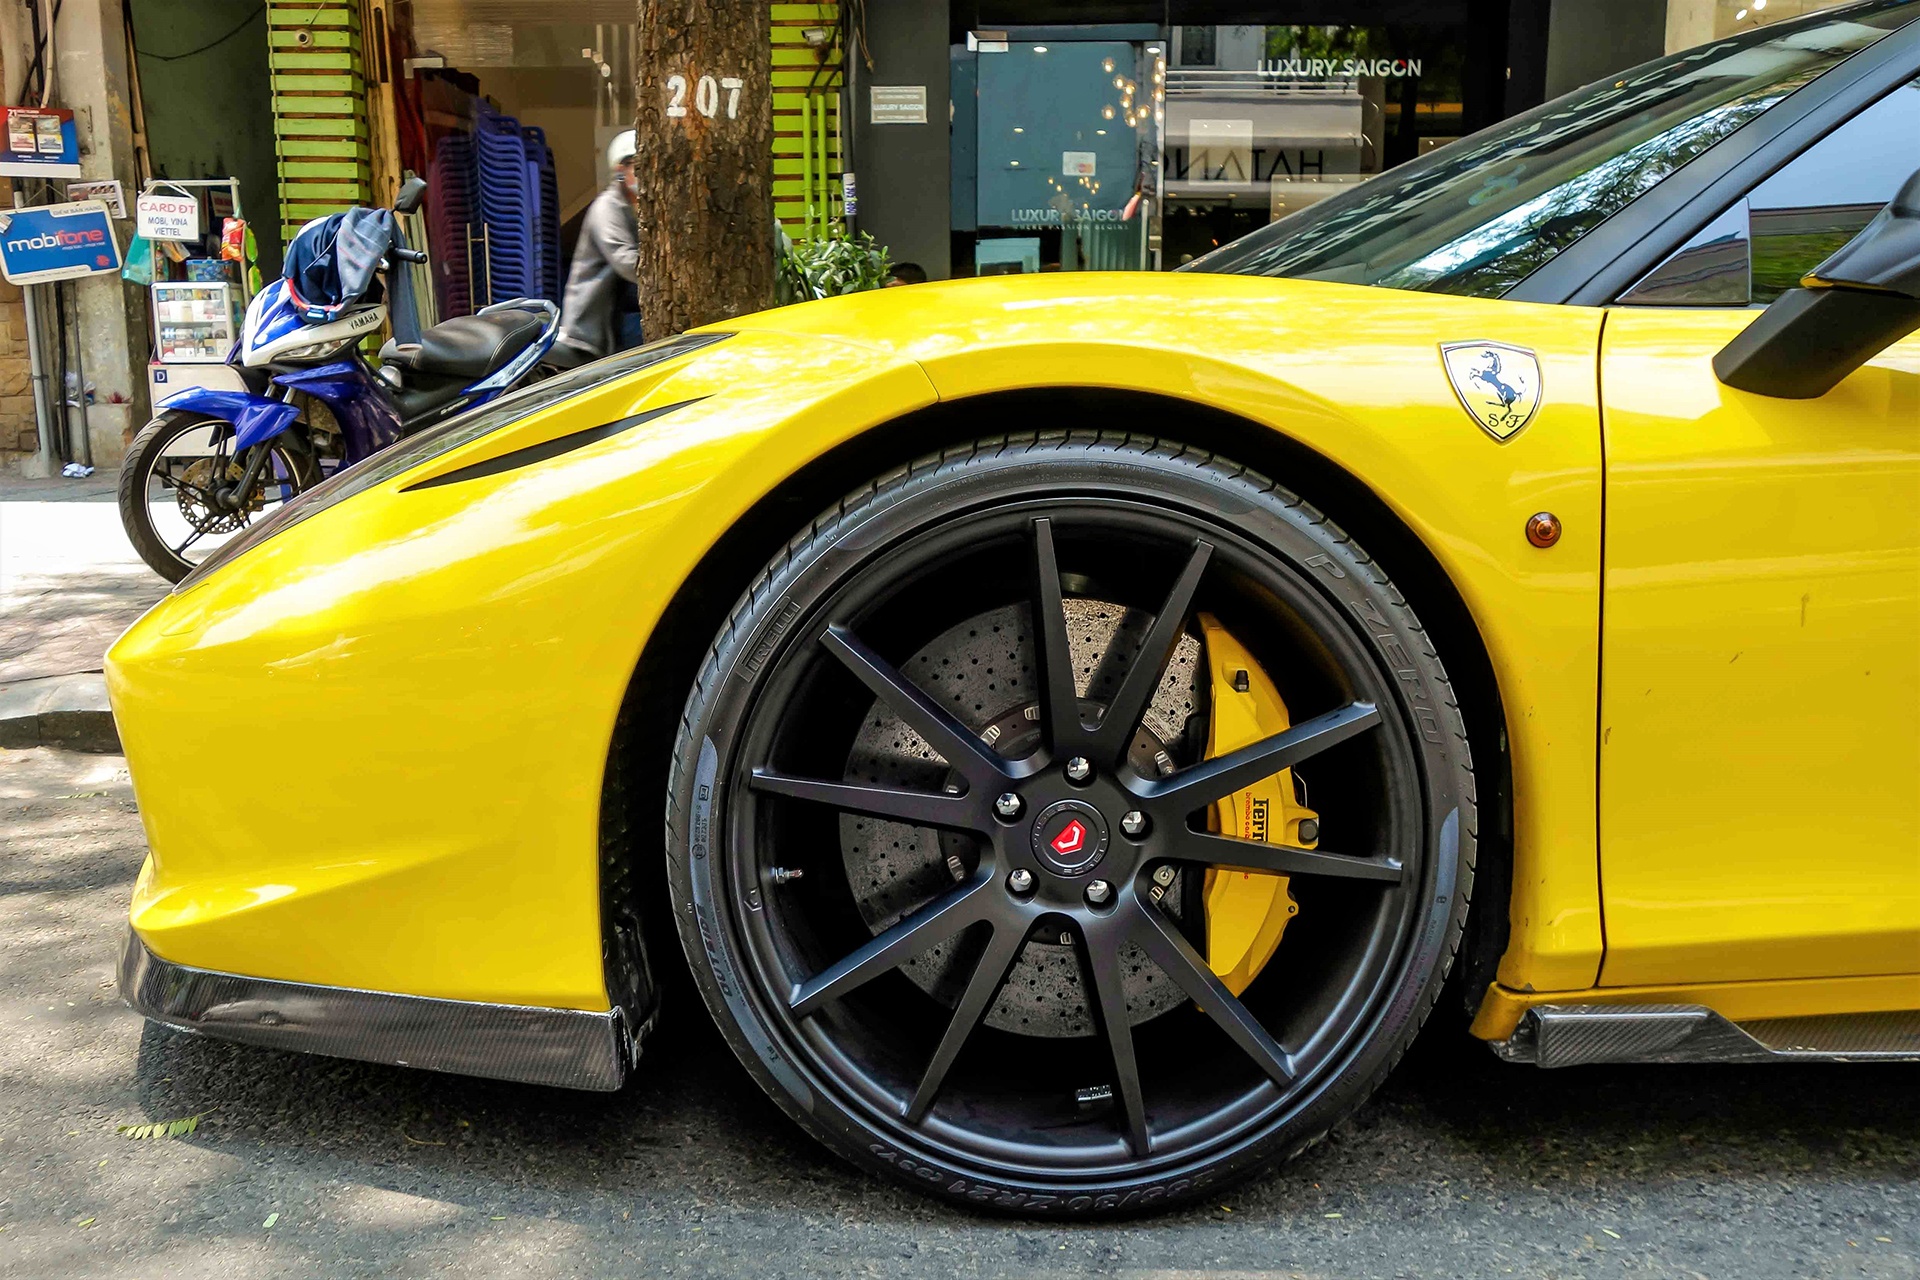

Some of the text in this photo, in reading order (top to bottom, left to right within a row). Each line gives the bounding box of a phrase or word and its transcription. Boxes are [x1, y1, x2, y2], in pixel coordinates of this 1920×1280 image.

[1257, 59, 1422, 77] LUXURY SAIGON
[667, 75, 744, 119] 207
[140, 202, 196, 215] CARD ĐT
[148, 216, 188, 226] MOBI, VINA
[7, 229, 104, 252] mobifone
[154, 227, 181, 236] VIETTEL
[348, 312, 379, 330] YAMAHA
[156, 371, 165, 382] D
[736, 595, 801, 683] PIRELLI
[1304, 553, 1444, 745] P ZERO
[1252, 798, 1269, 842] Ferr
